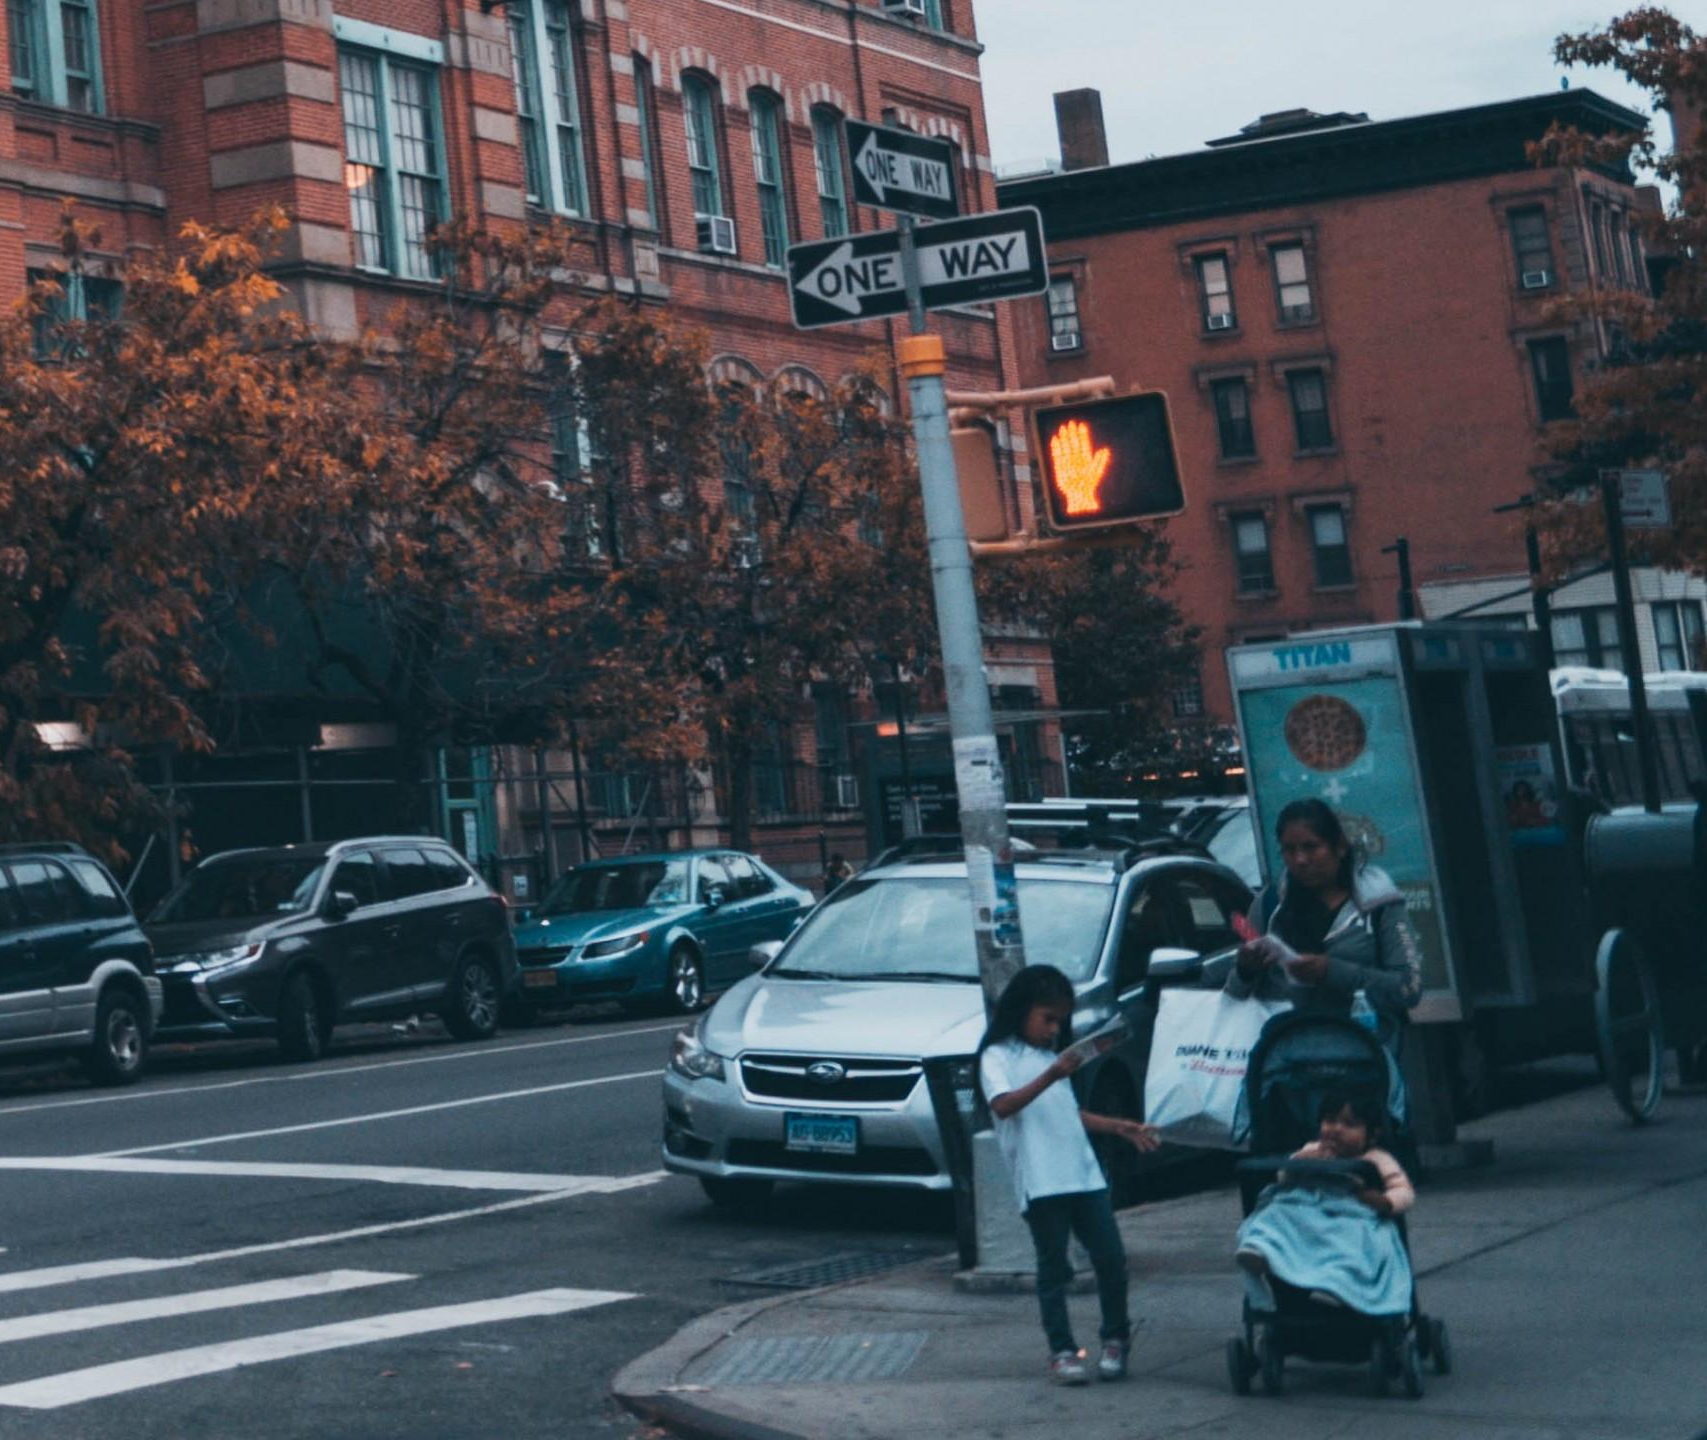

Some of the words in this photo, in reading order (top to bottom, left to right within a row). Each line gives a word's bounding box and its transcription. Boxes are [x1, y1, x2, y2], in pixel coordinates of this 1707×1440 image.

[866, 150, 899, 185] ONE
[910, 160, 942, 194] WAY
[817, 257, 897, 298] ONE
[939, 237, 1017, 279] WAY
[1273, 642, 1351, 670] TITAN
